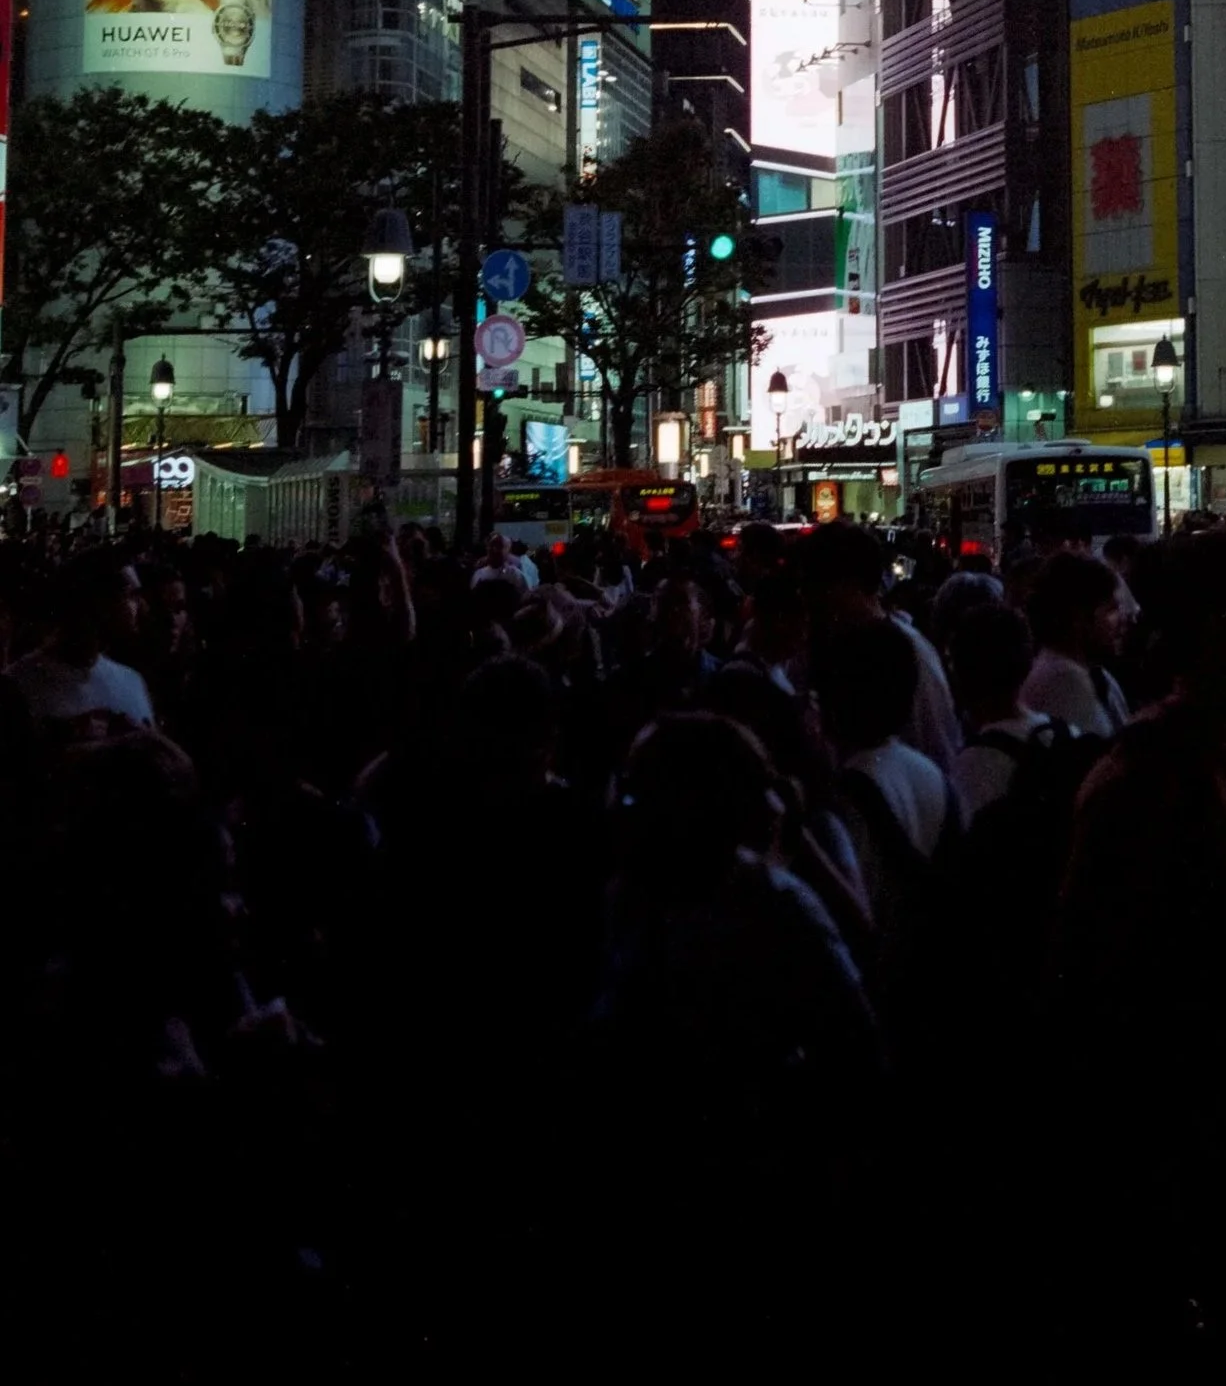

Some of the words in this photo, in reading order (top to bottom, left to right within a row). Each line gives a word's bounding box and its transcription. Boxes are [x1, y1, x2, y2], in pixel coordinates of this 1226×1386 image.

[102, 26, 191, 43] HUAWEI
[102, 47, 142, 58] WATCH
[163, 48, 170, 57] 6
[171, 49, 190, 58] Pro
[977, 226, 993, 290] MIZUHO
[975, 335, 991, 404] みずほ銀行
